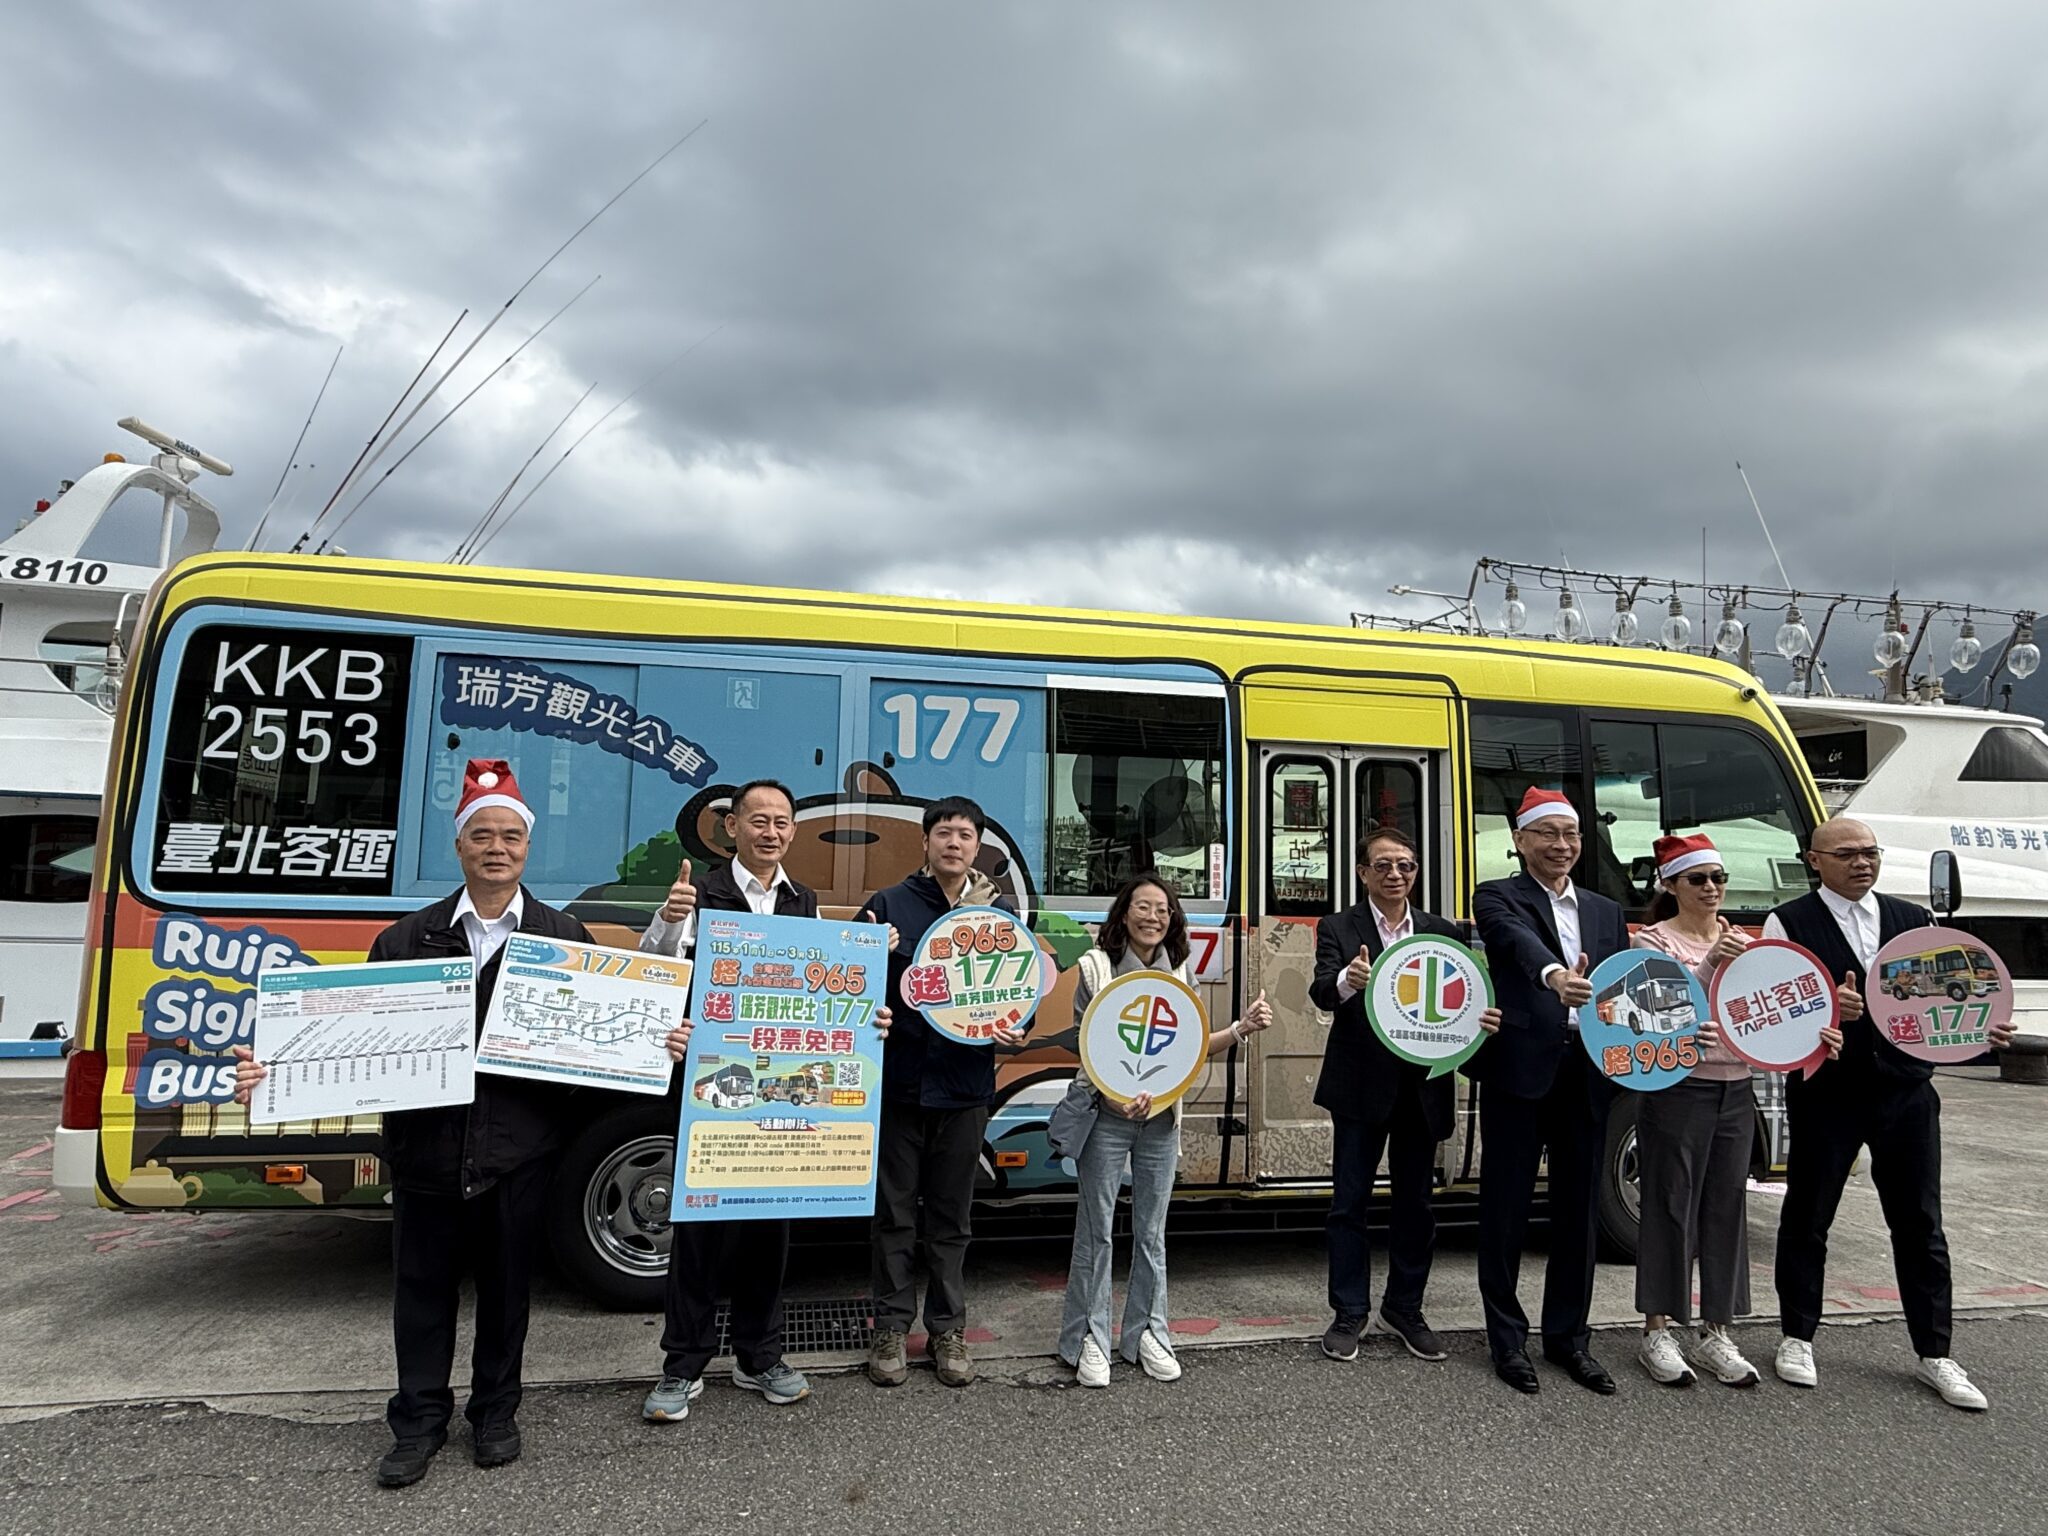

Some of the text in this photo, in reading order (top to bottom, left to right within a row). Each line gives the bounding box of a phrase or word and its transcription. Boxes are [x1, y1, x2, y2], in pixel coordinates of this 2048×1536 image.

[213, 641, 385, 702] KKB
[202, 704, 380, 766] 2553
[456, 665, 706, 778] 瑞芳觀光公車
[883, 693, 1020, 762] 177
[156, 822, 397, 879] 臺北客運
[952, 921, 1018, 956] 965
[442, 965, 472, 977] 965
[580, 950, 633, 977] 177
[805, 961, 867, 996] 965
[909, 950, 1035, 1005] 送 177
[1391, 950, 1430, 979] DEVELOPMENT
[1455, 961, 1472, 986] CENTER
[703, 991, 735, 1024] 送
[739, 993, 818, 1024] 瑞芳觀光巴士
[821, 996, 876, 1028] 177
[954, 986, 1036, 1007] 瑞芳觀光巴士
[1724, 972, 1823, 1025] 臺北客運
[1734, 997, 1826, 1037] TAIPEI BUS
[1888, 1003, 1992, 1044] 送 177
[722, 1027, 856, 1055] 一段票免費
[1634, 1035, 1700, 1073] 965
[147, 1059, 236, 1103] Bus
